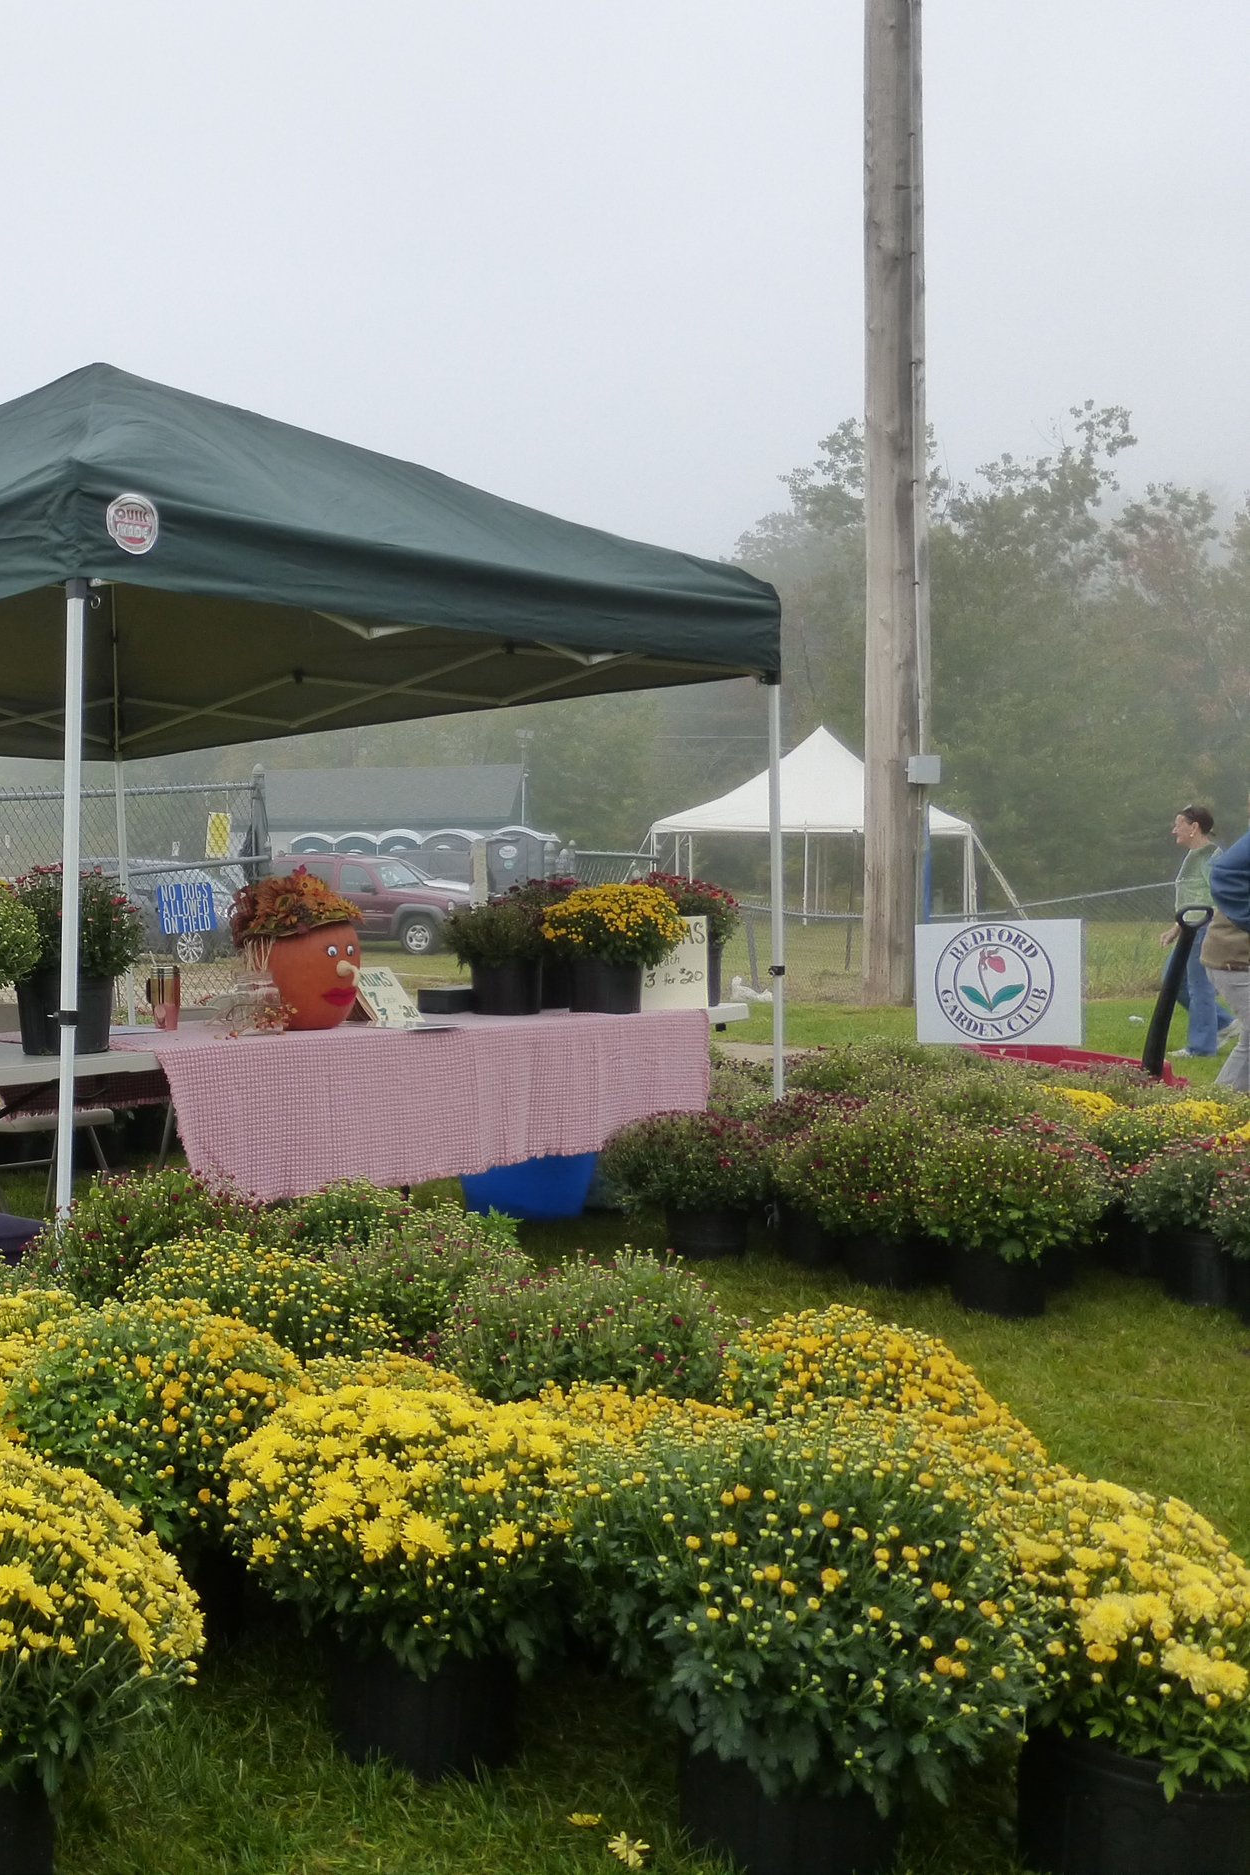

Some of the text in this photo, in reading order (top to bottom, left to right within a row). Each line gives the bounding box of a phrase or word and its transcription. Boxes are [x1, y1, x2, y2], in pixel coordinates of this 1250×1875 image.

[161, 883, 208, 902] NO DOGS
[163, 899, 210, 918] ALLOWED
[164, 914, 211, 935] ON FIELD
[949, 927, 1039, 961] BEDFORD
[644, 972, 656, 988] 3
[941, 987, 1048, 1037] GARDEN CLUB
